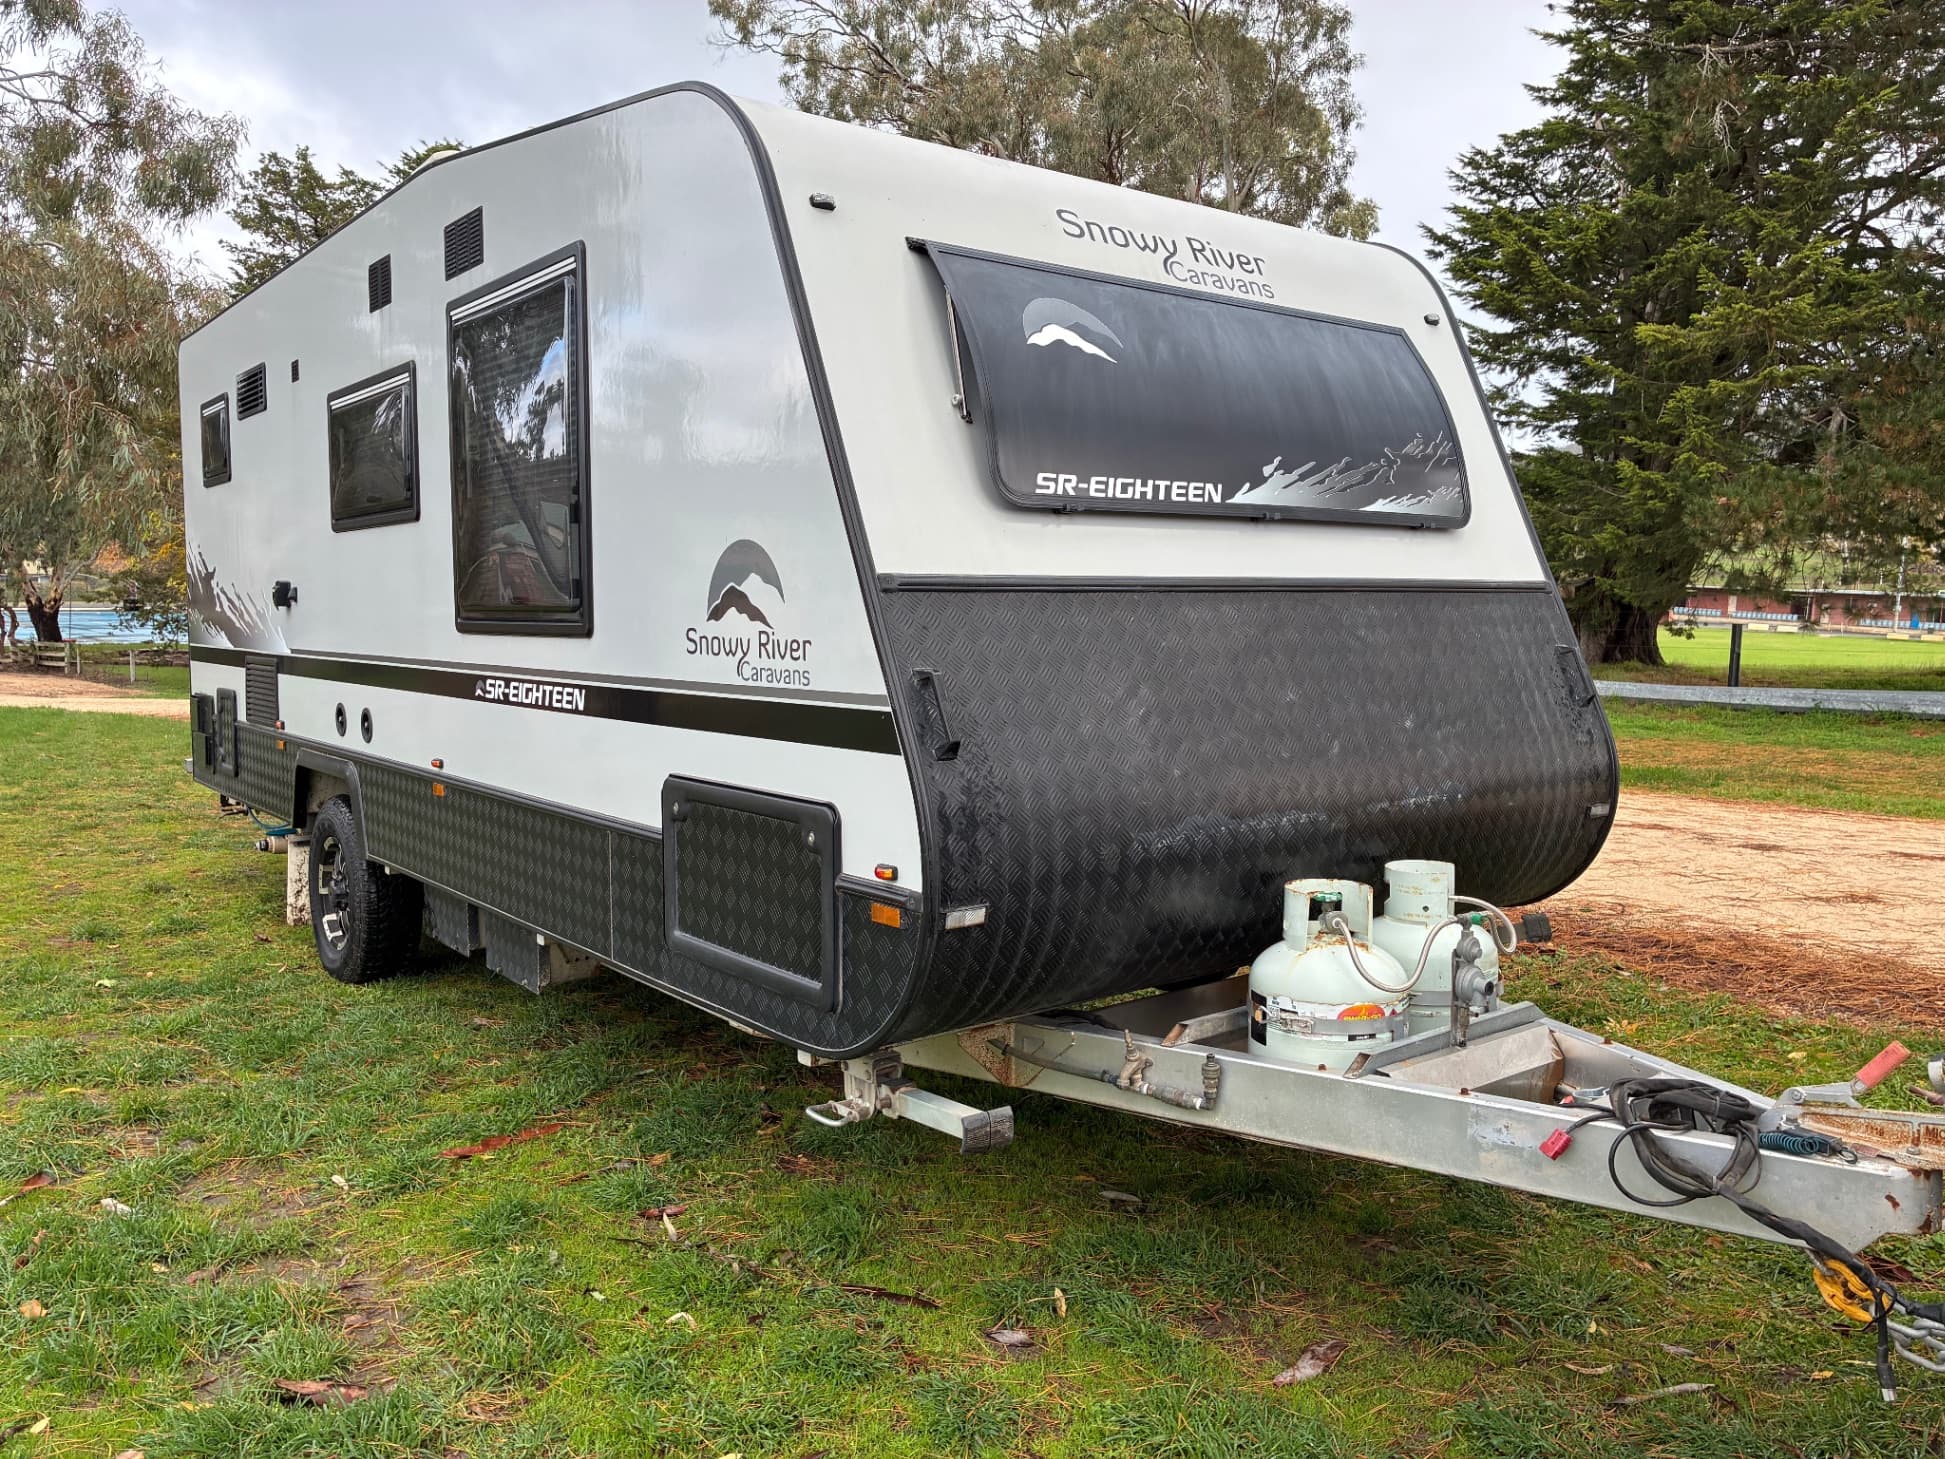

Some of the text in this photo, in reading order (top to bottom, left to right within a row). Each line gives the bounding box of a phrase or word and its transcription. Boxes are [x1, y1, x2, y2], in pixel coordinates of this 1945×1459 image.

[1056, 208, 1265, 277] Snowy River
[1168, 260, 1275, 299] Caravans
[1035, 472, 1223, 504] SR-EIGHTEEN
[685, 628, 812, 677] Snowy River
[740, 660, 811, 687] Caravans
[485, 678, 586, 711] SR-EIGHTEEN
